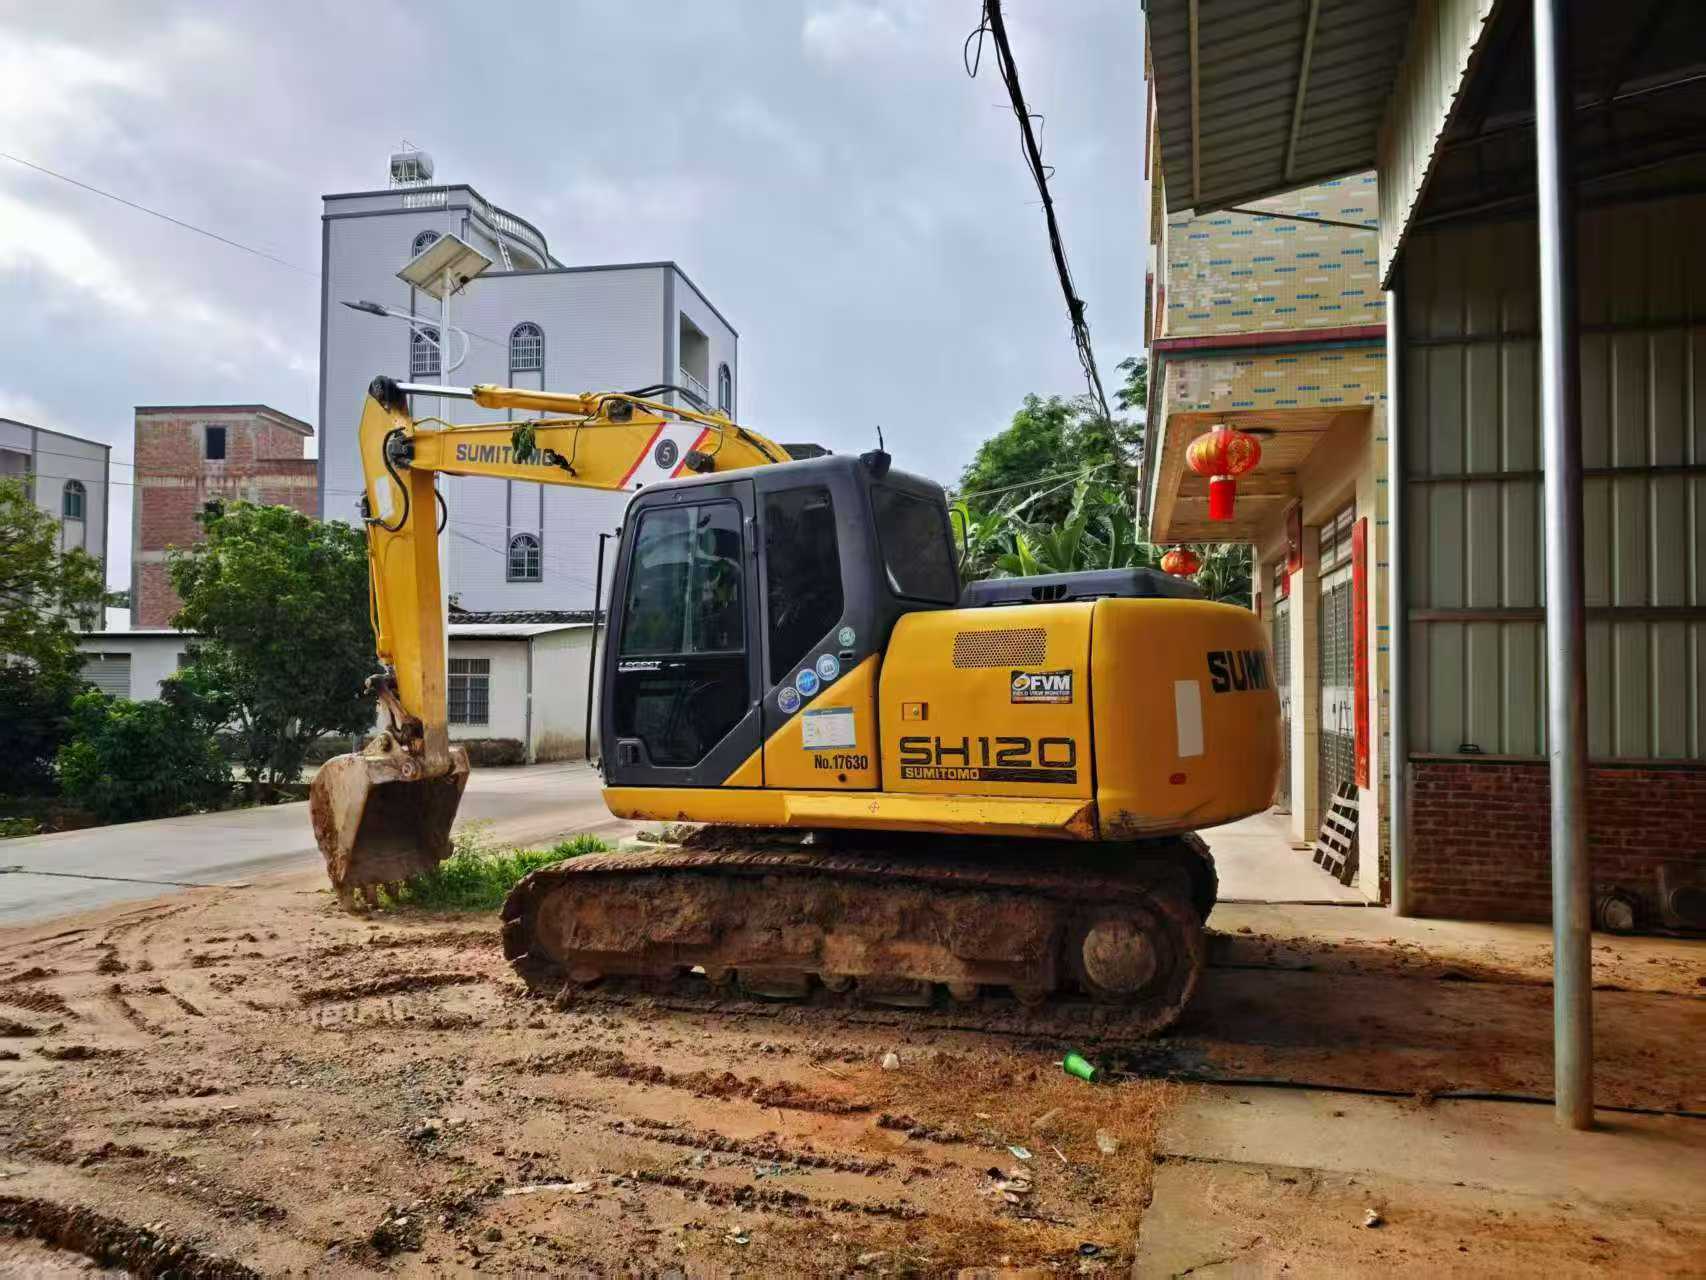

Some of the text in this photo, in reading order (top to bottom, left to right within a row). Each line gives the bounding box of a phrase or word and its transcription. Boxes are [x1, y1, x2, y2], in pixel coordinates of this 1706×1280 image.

[1030, 675, 1071, 690] FVM
[900, 736, 1077, 768] SH120
[814, 754, 869, 770] No.17630
[905, 766, 980, 780] SUMITOMO
